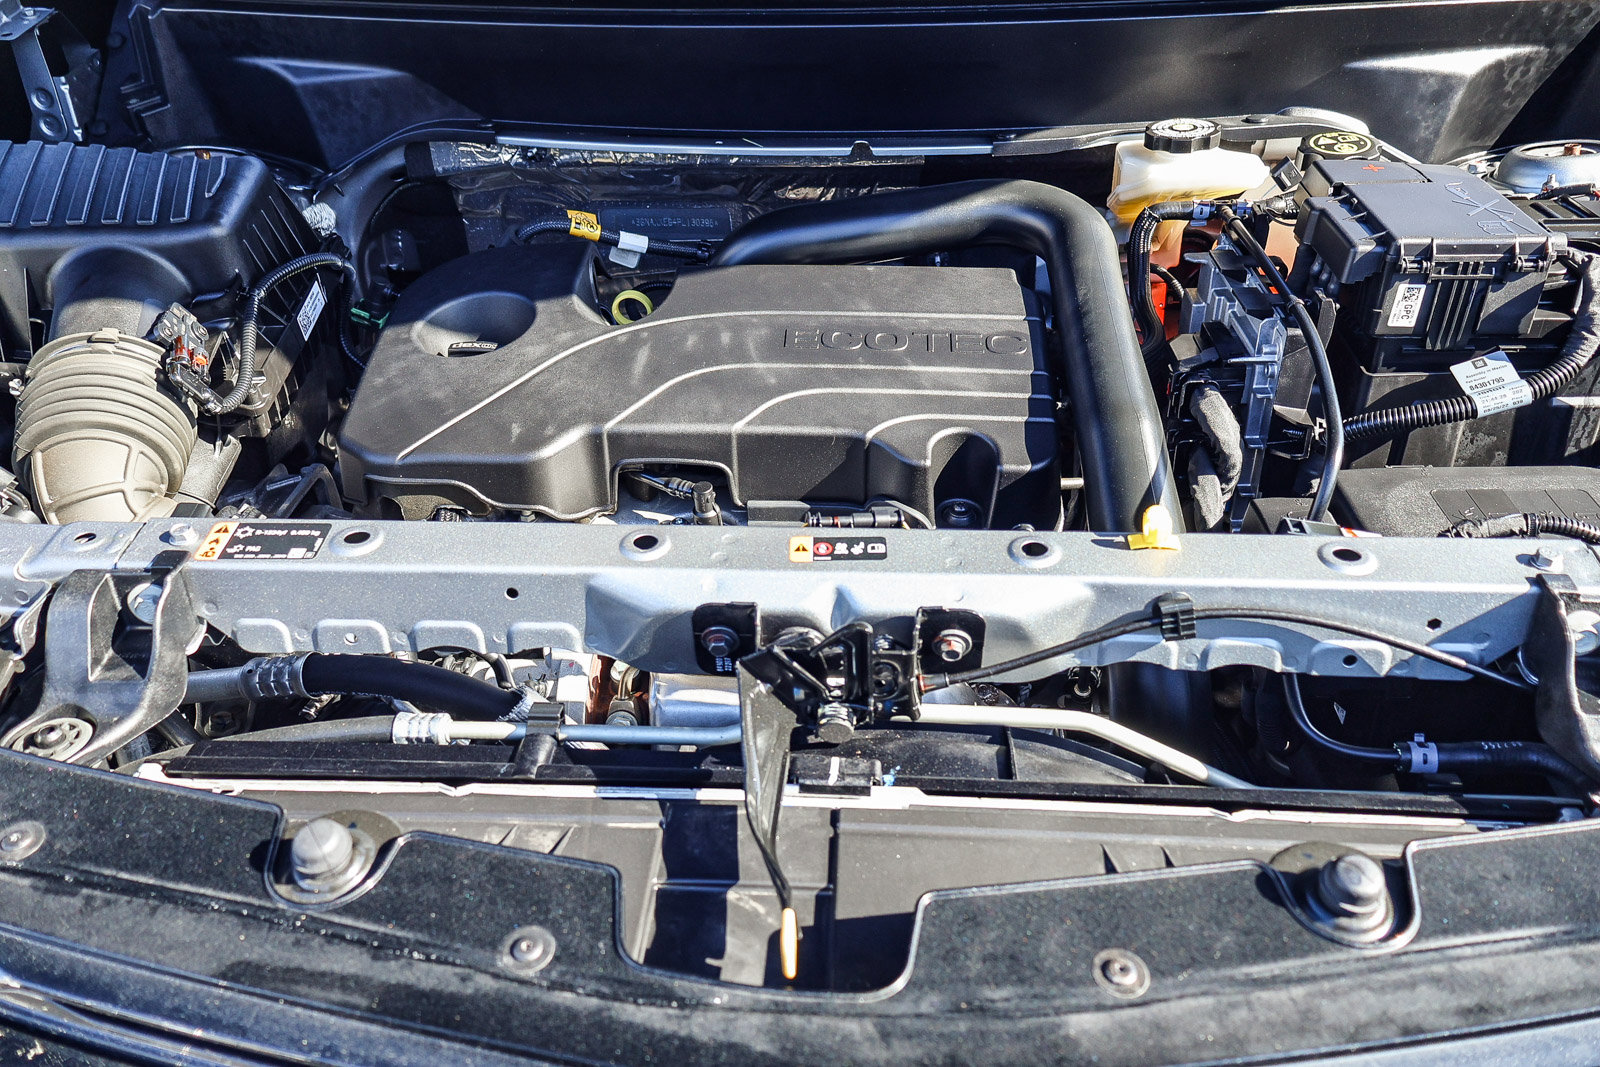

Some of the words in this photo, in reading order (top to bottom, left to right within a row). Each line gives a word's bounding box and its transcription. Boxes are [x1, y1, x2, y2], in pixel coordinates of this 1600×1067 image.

[1401, 304, 1413, 320] GPC
[782, 328, 1029, 355] ECOTEC
[1469, 376, 1505, 391] 84301795
